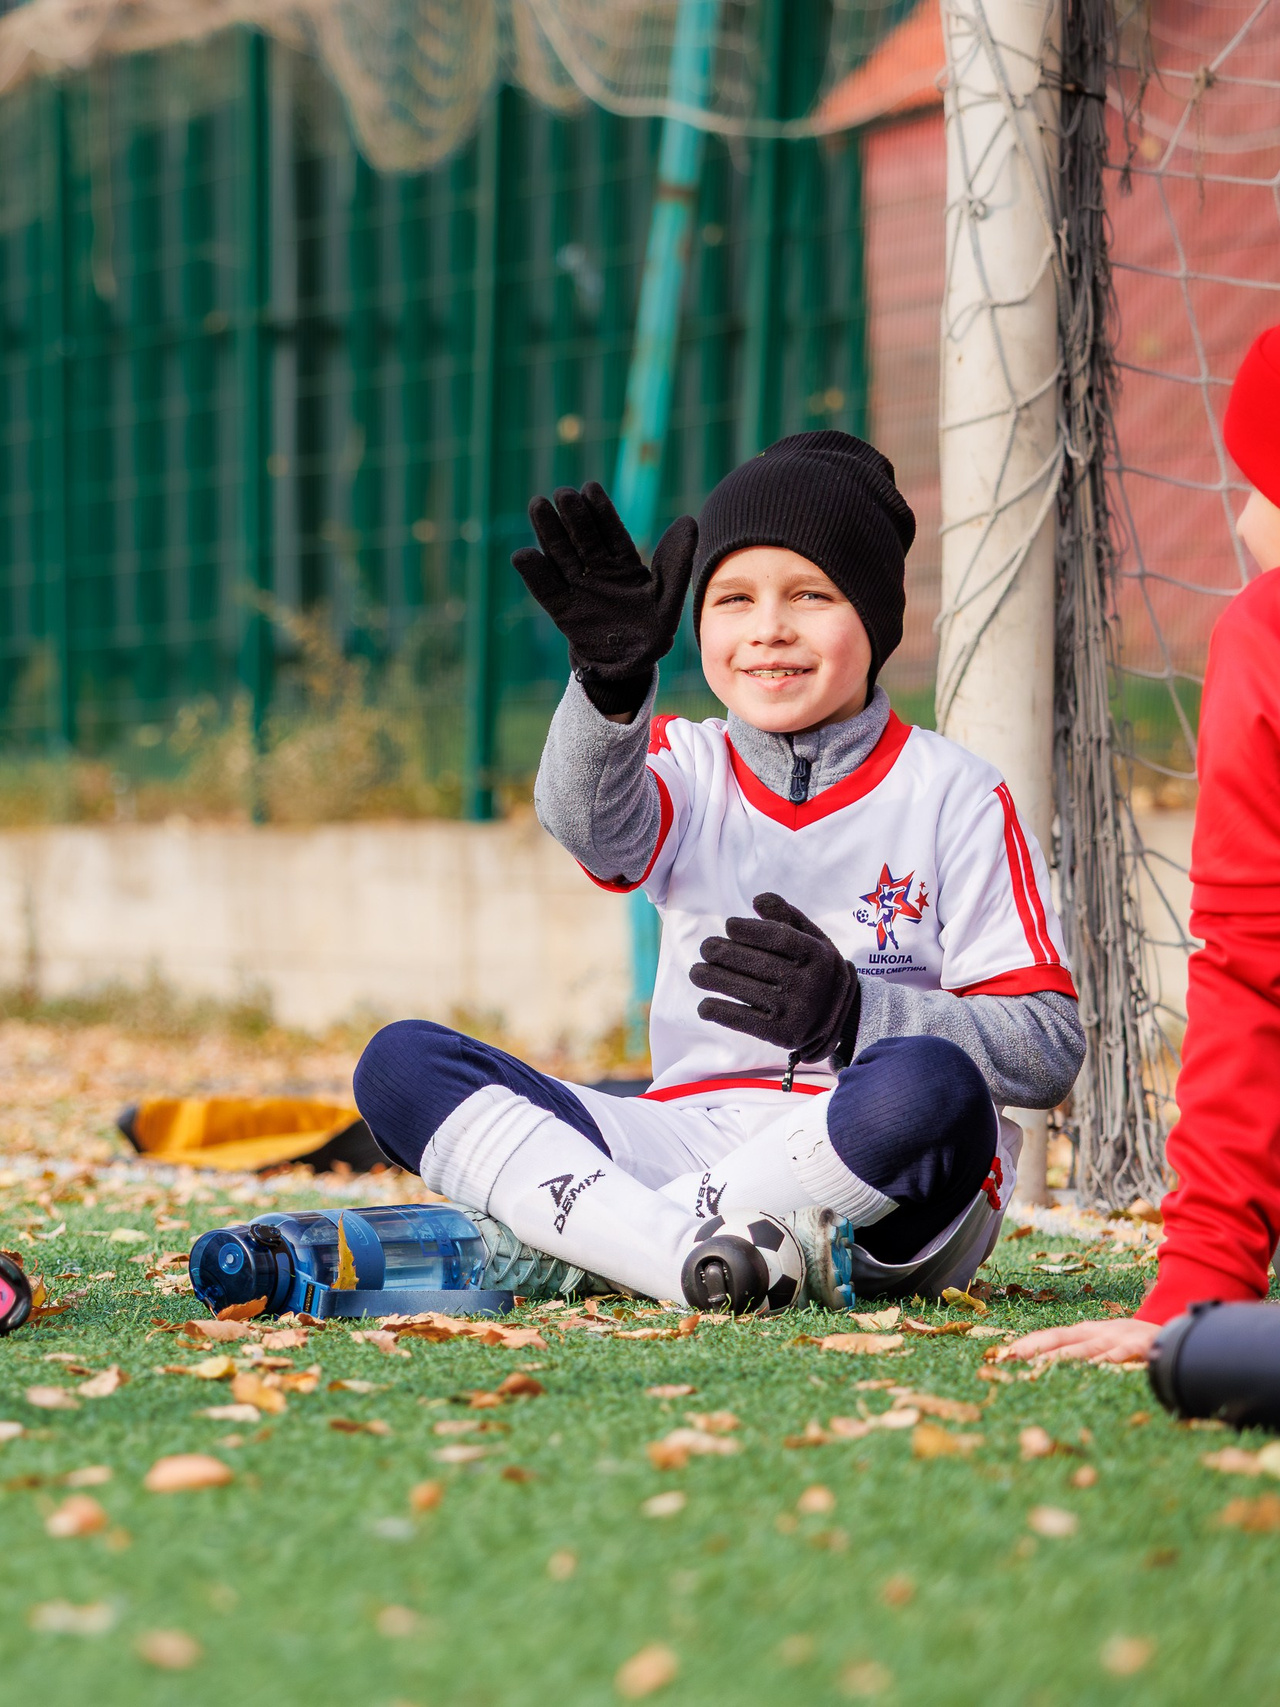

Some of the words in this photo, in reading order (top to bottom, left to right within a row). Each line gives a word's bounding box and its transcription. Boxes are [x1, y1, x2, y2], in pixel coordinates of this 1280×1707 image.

[869, 954, 913, 964] ШКОЛА
[857, 967, 885, 976] ЛЕКСЕЯ
[886, 966, 927, 975] СМЕРТИНА
[554, 1169, 606, 1235] DEMIX
